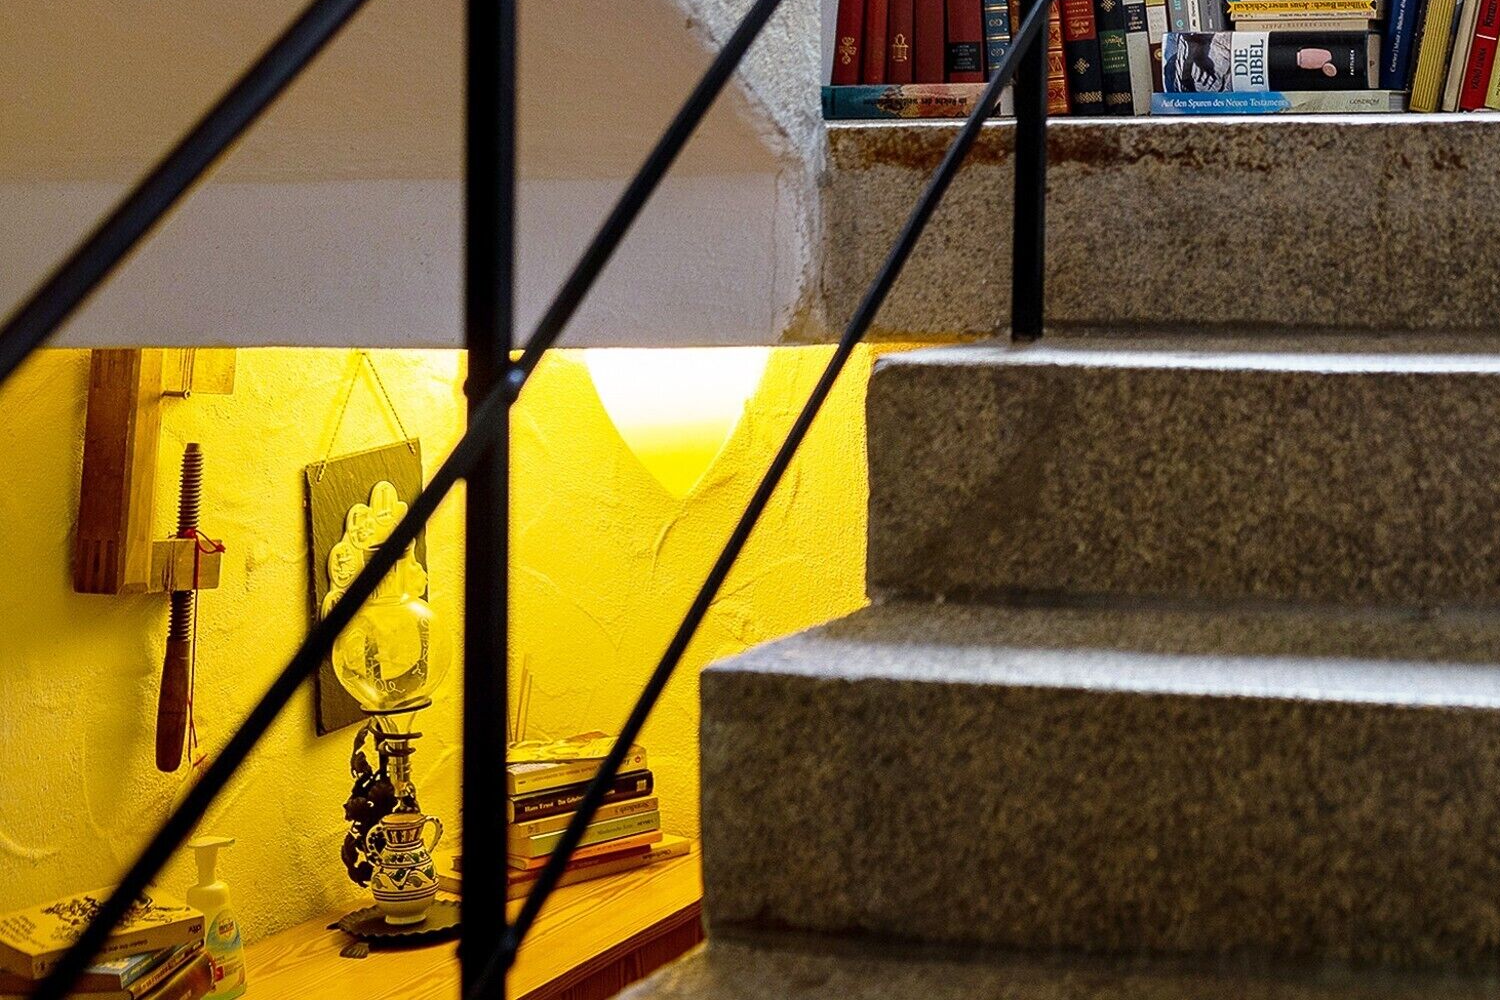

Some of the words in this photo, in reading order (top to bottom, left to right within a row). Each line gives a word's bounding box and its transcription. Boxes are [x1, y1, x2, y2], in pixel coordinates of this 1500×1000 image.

[1233, 3, 1267, 11] Schicksal
[1290, 2, 1309, 10] Jesus
[1336, 1, 1368, 9] Wilhelm
[1234, 47, 1248, 77] DIE
[1251, 39, 1264, 86] BIBEL
[1161, 98, 1175, 109] Auf
[1175, 98, 1187, 108] den
[1187, 98, 1212, 109] Spuren
[1212, 99, 1224, 107] des
[1226, 98, 1248, 107] Neuen
